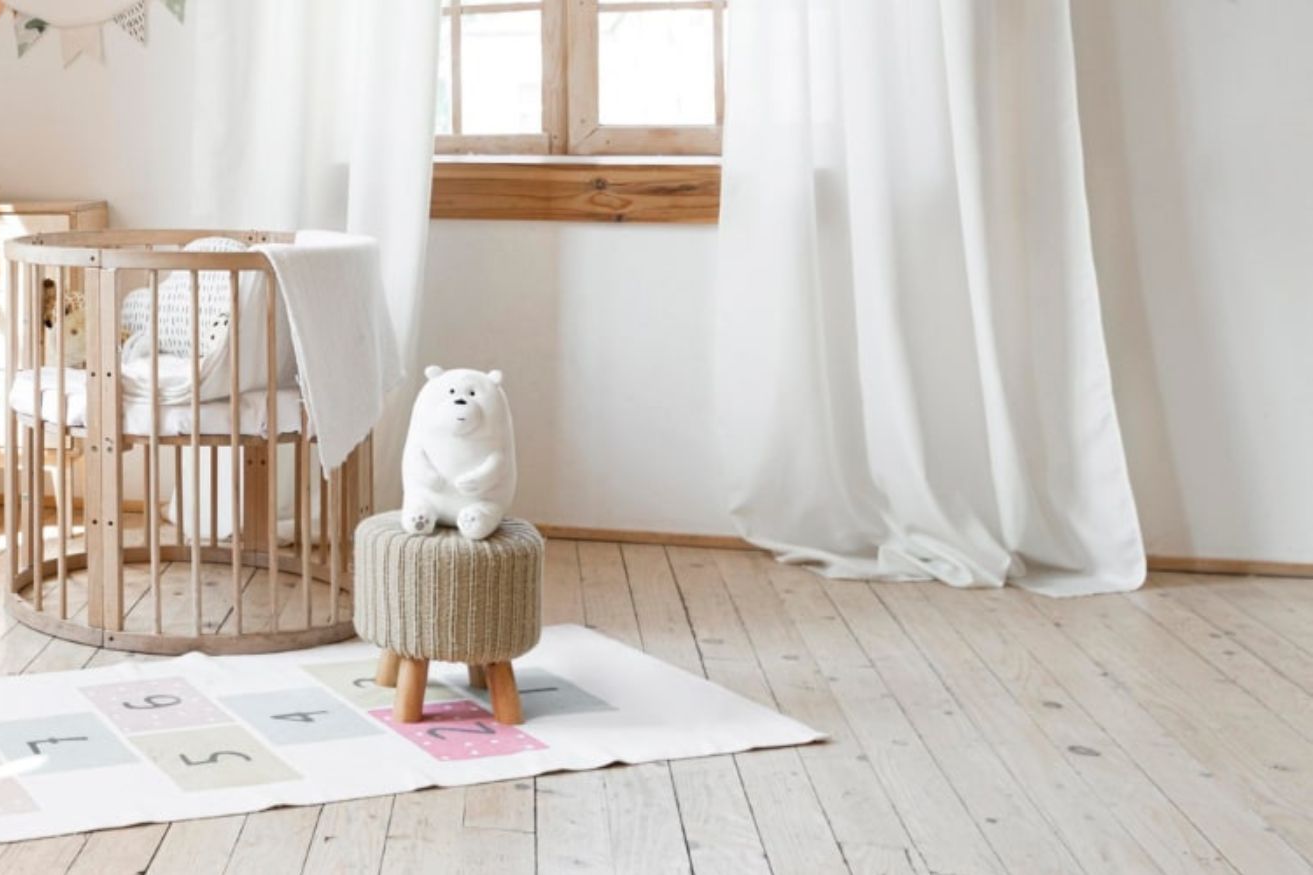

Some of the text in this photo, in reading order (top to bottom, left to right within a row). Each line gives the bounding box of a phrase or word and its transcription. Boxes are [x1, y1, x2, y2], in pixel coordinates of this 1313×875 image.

[122, 693, 182, 710] 6
[269, 709, 328, 723] 4
[426, 721, 496, 740] 2
[26, 735, 89, 755] 7
[179, 752, 252, 767] 5
